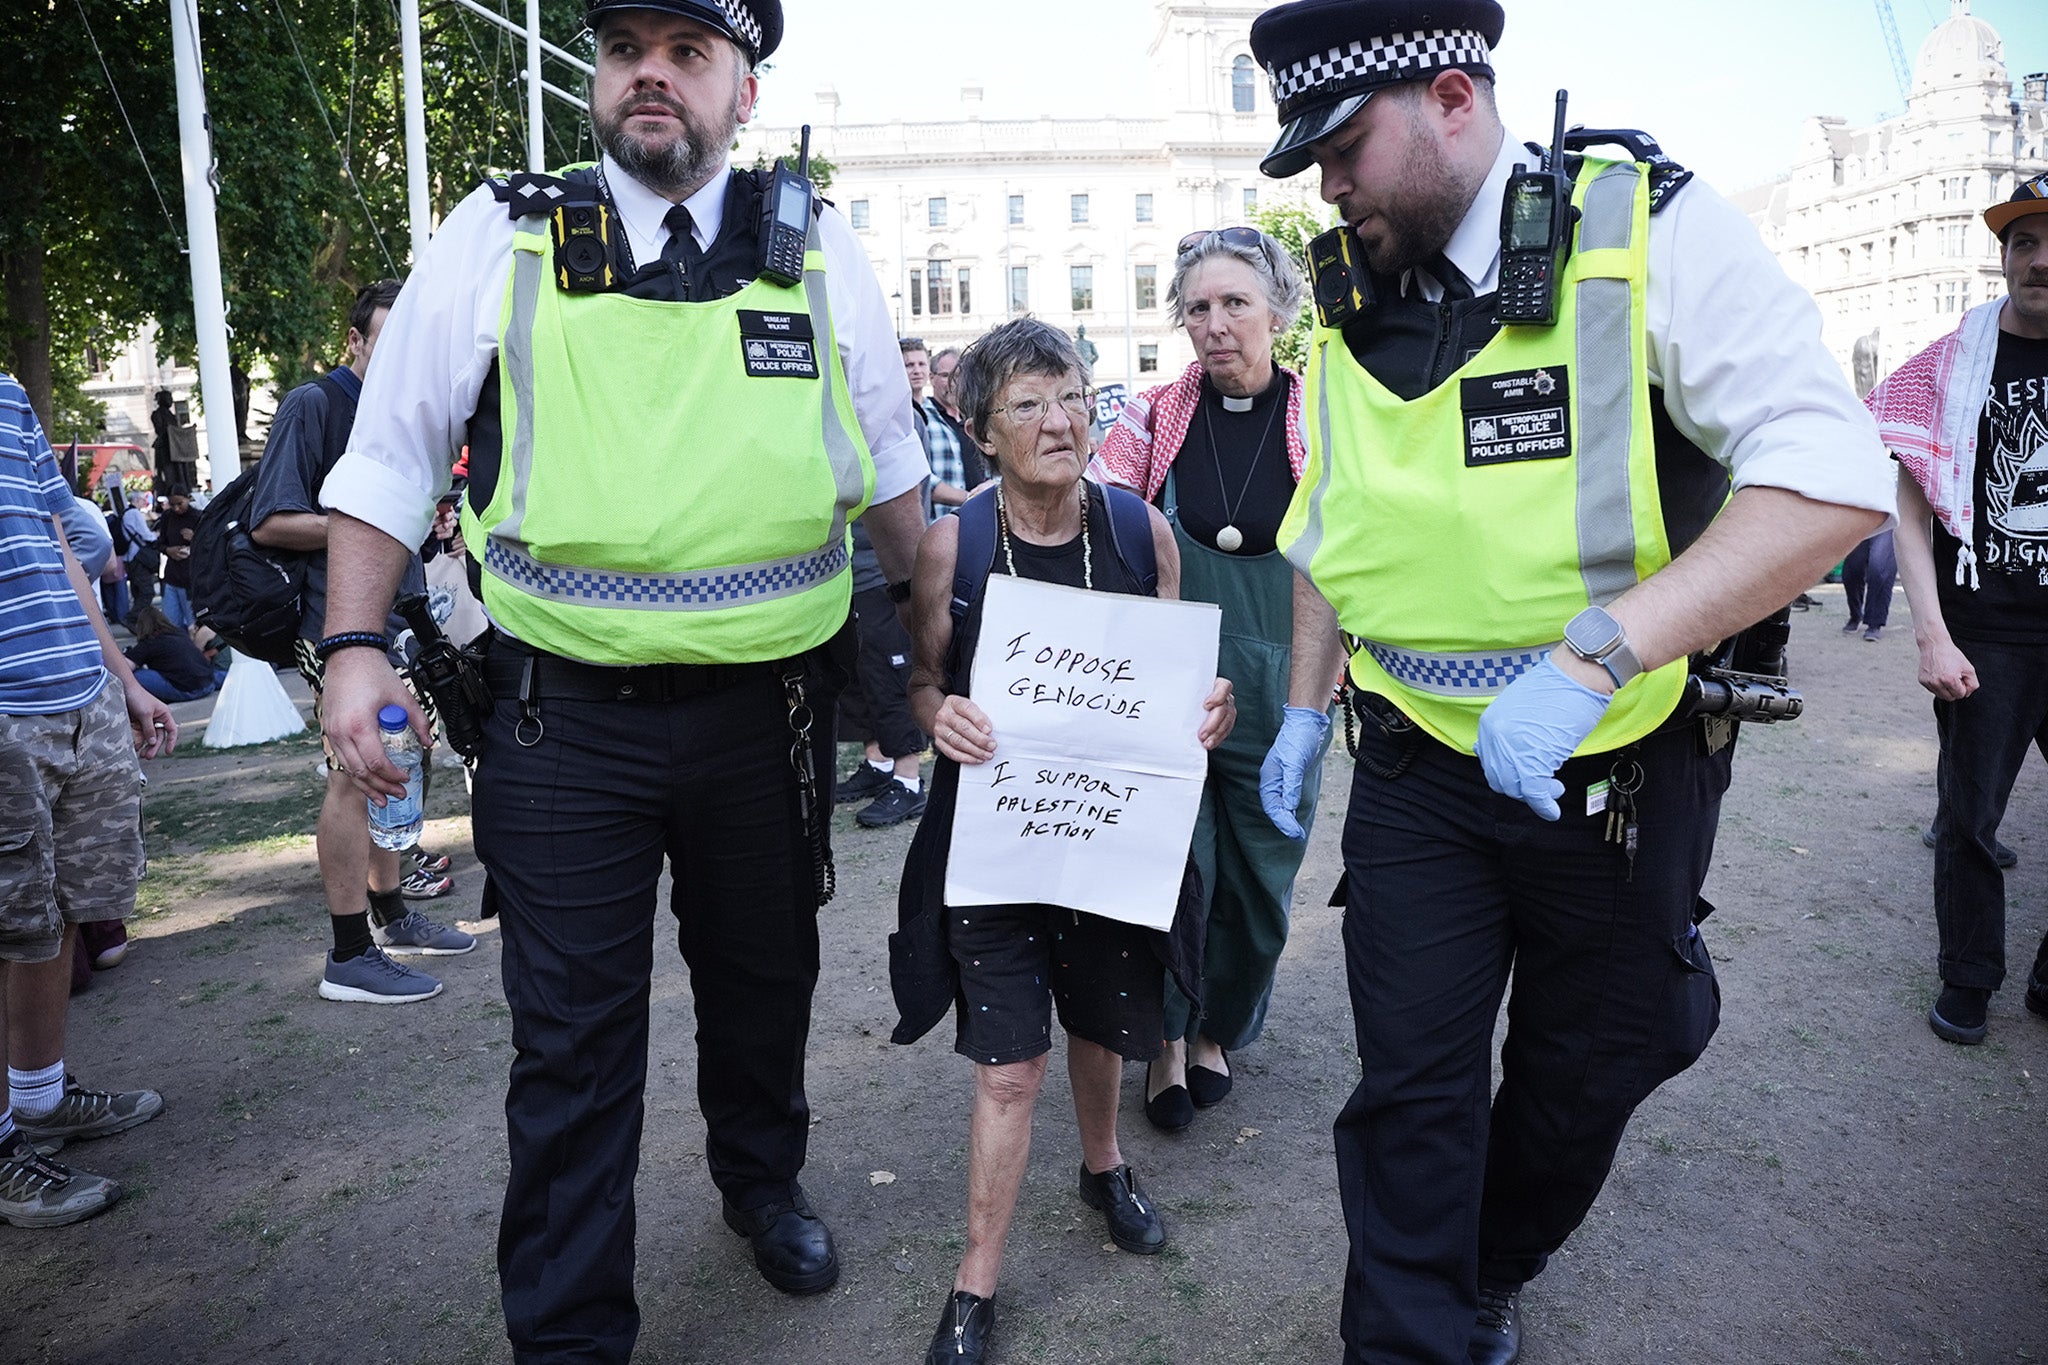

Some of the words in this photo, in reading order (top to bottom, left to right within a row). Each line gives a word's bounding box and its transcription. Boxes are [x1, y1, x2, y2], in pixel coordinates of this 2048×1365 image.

[769, 343, 807, 351] METROPOLITAN
[776, 349, 803, 358] POLICE
[750, 361, 780, 370] POLICE
[781, 362, 813, 372] OFFICER
[1492, 377, 1534, 390] CONSTABLE
[1503, 388, 1524, 398] AMIN
[1501, 412, 1557, 426] METROPOLITAN
[1510, 421, 1551, 435] POLICE
[1472, 443, 1513, 458] POLICE
[1516, 437, 1565, 453] OFFICER
[1006, 632, 1031, 662] I
[1034, 646, 1136, 684] OPPOSE
[991, 760, 1017, 788] I
[1035, 769, 1140, 803] SUPPORT
